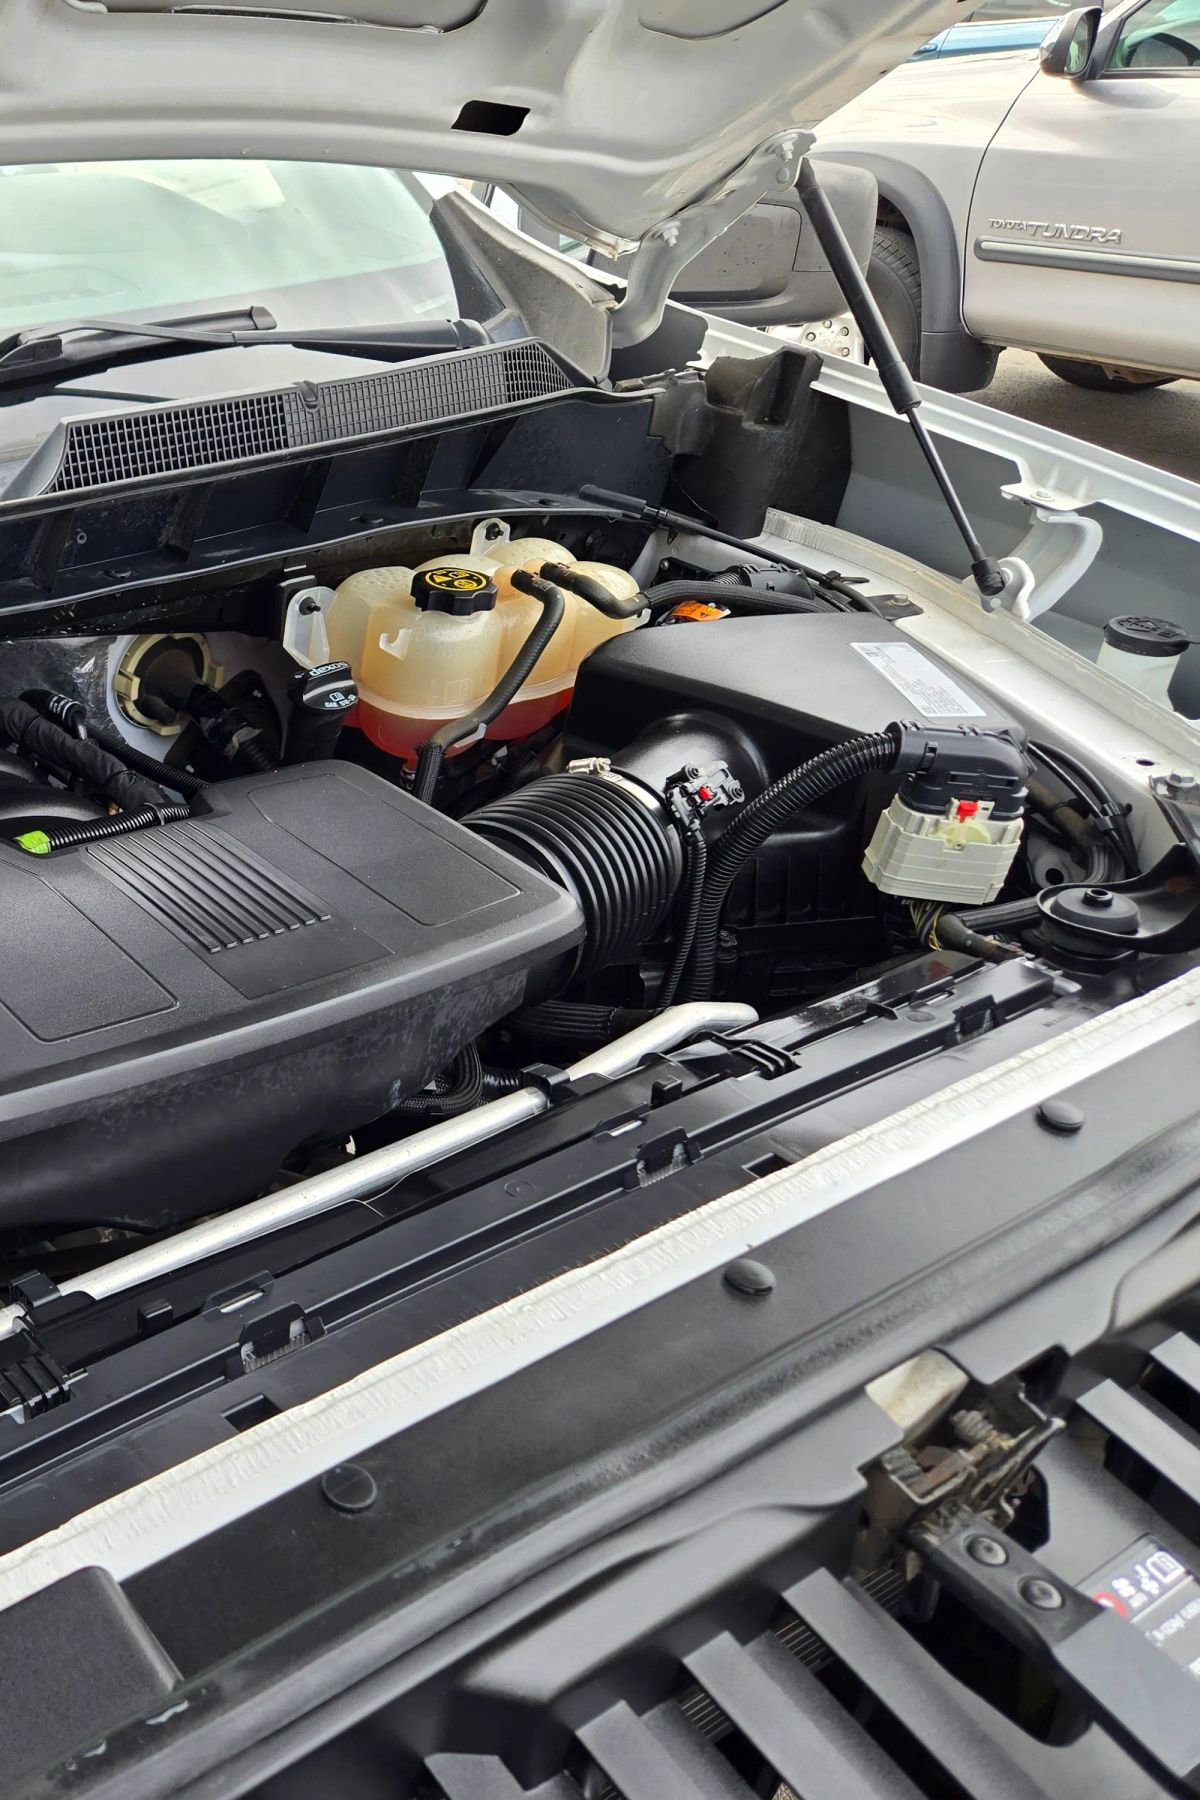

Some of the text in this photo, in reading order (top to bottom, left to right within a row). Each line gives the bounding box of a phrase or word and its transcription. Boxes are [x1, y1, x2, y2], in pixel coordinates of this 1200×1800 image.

[988, 218, 1122, 244] TOYOTA TUNDRA
[309, 662, 348, 677] dexos
